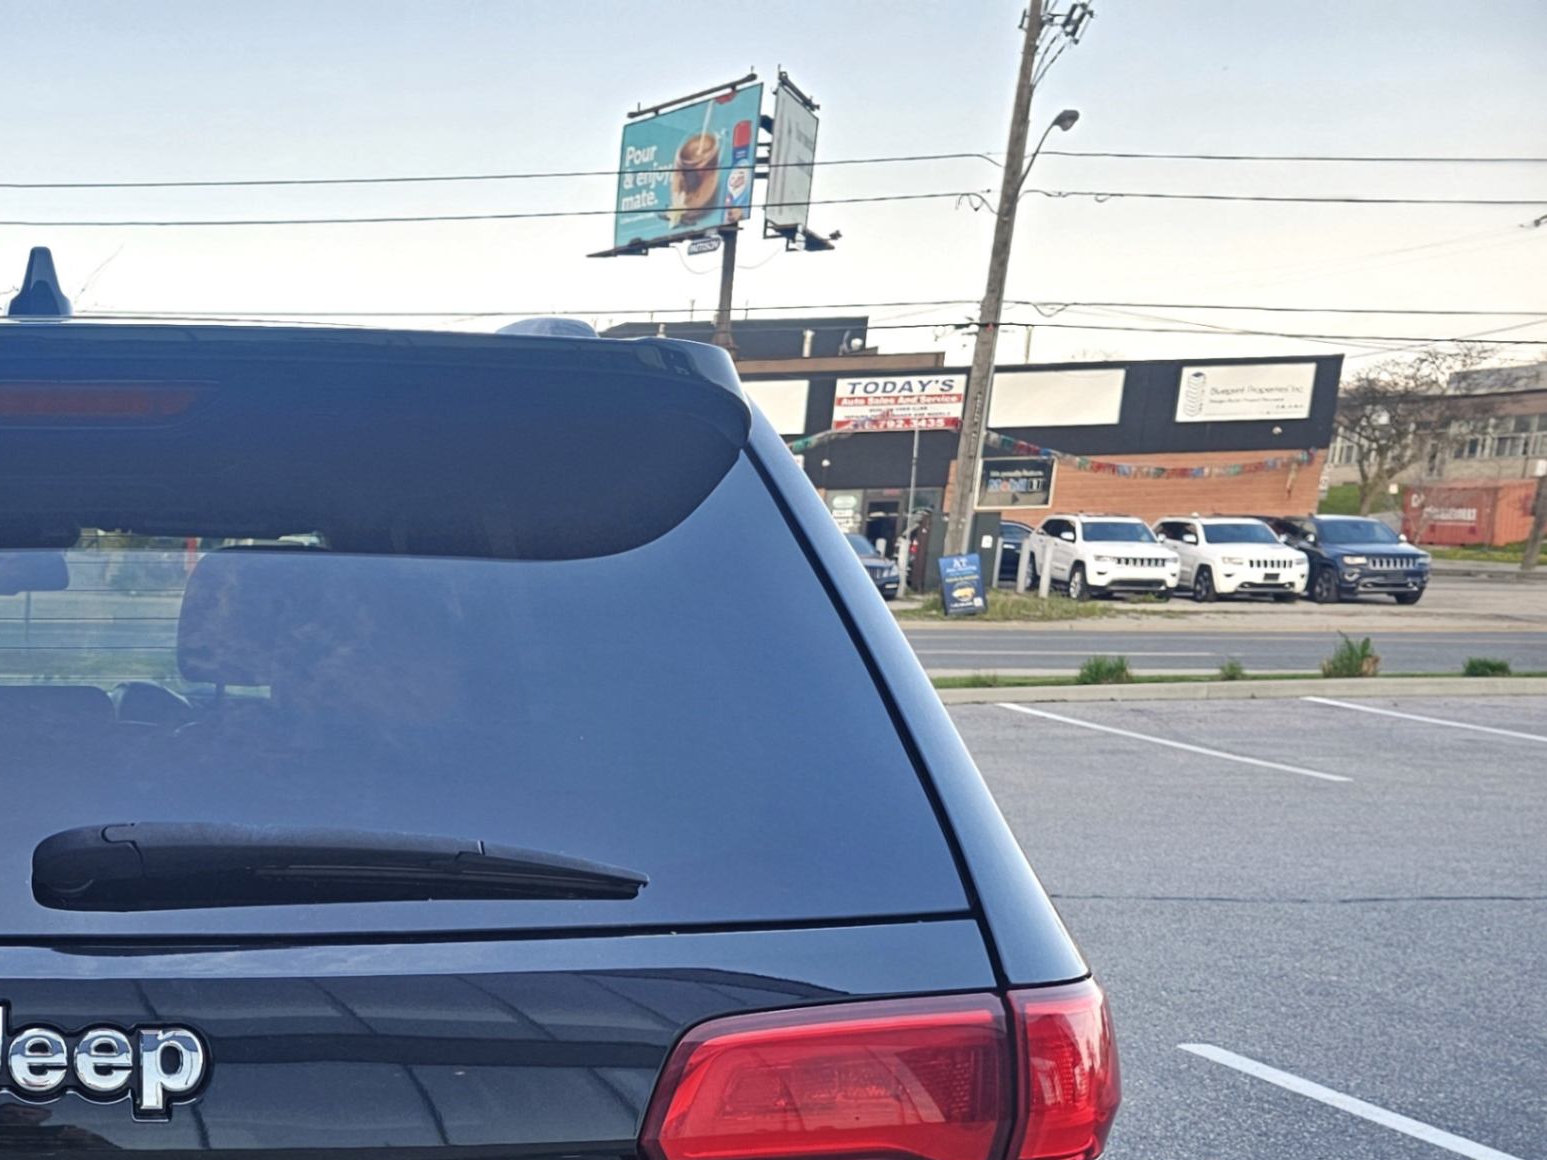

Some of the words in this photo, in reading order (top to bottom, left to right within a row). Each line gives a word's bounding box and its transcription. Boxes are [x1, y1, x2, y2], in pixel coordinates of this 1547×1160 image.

[625, 146, 657, 167] Pour
[636, 162, 673, 189] enjoy
[621, 190, 659, 212] mate.
[847, 379, 955, 395] TODAY'S
[840, 397, 866, 406] Auto
[868, 396, 895, 405] Sales
[920, 394, 959, 403] Service
